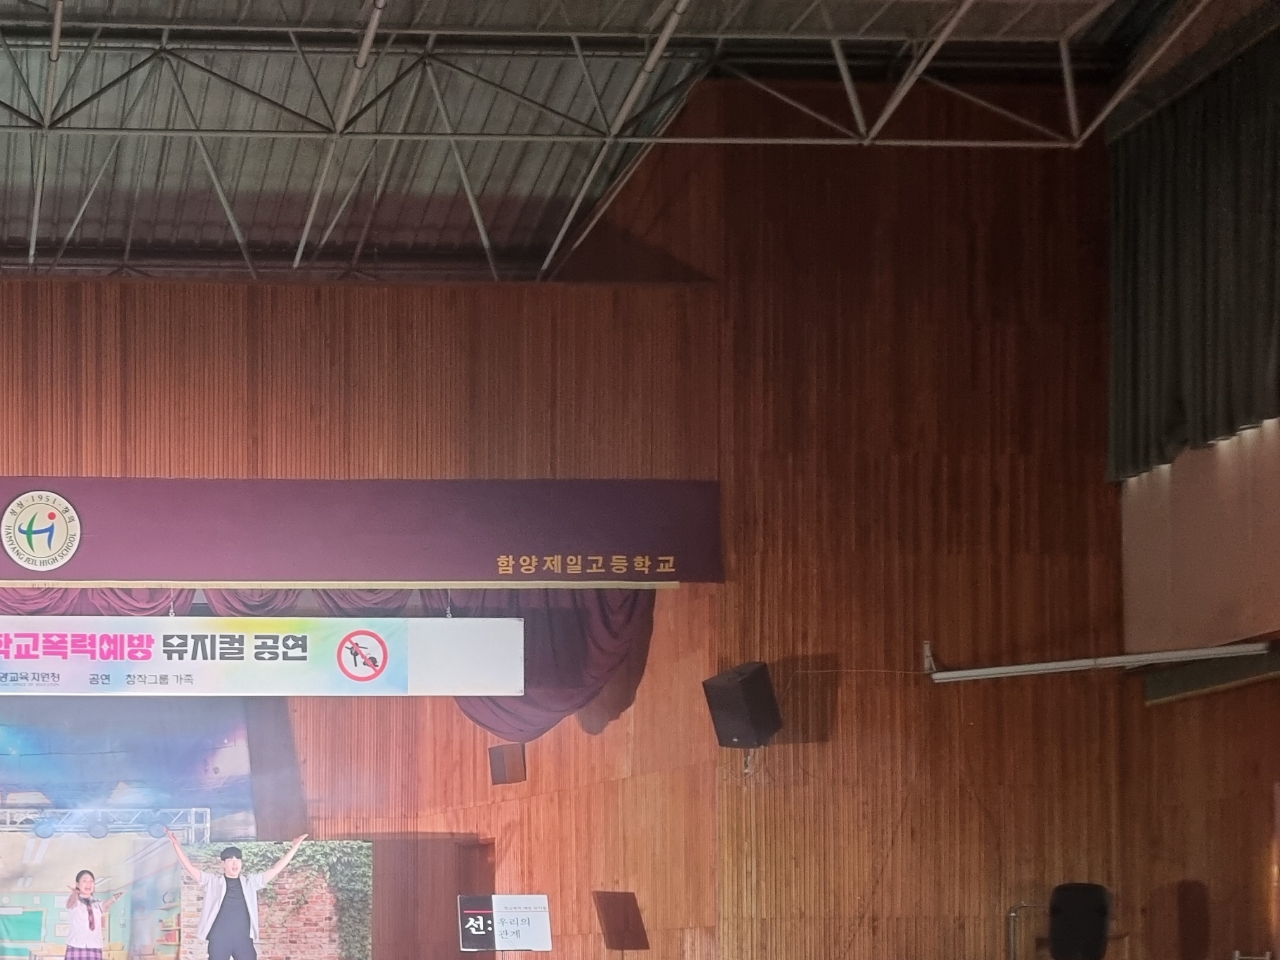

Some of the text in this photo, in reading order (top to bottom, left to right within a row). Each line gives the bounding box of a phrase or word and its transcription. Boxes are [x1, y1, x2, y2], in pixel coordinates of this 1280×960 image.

[4, 525, 77, 567] HAMYANG JEIL HIGH SCHOOL
[496, 554, 677, 575] 함양제일고등학교
[162, 633, 245, 661] 뮤지컬
[253, 633, 308, 662] 공연
[88, 673, 111, 685] 공연
[125, 673, 194, 686] 창작그룹 가족
[498, 916, 531, 927] 우리의
[498, 928, 521, 939] 관계
